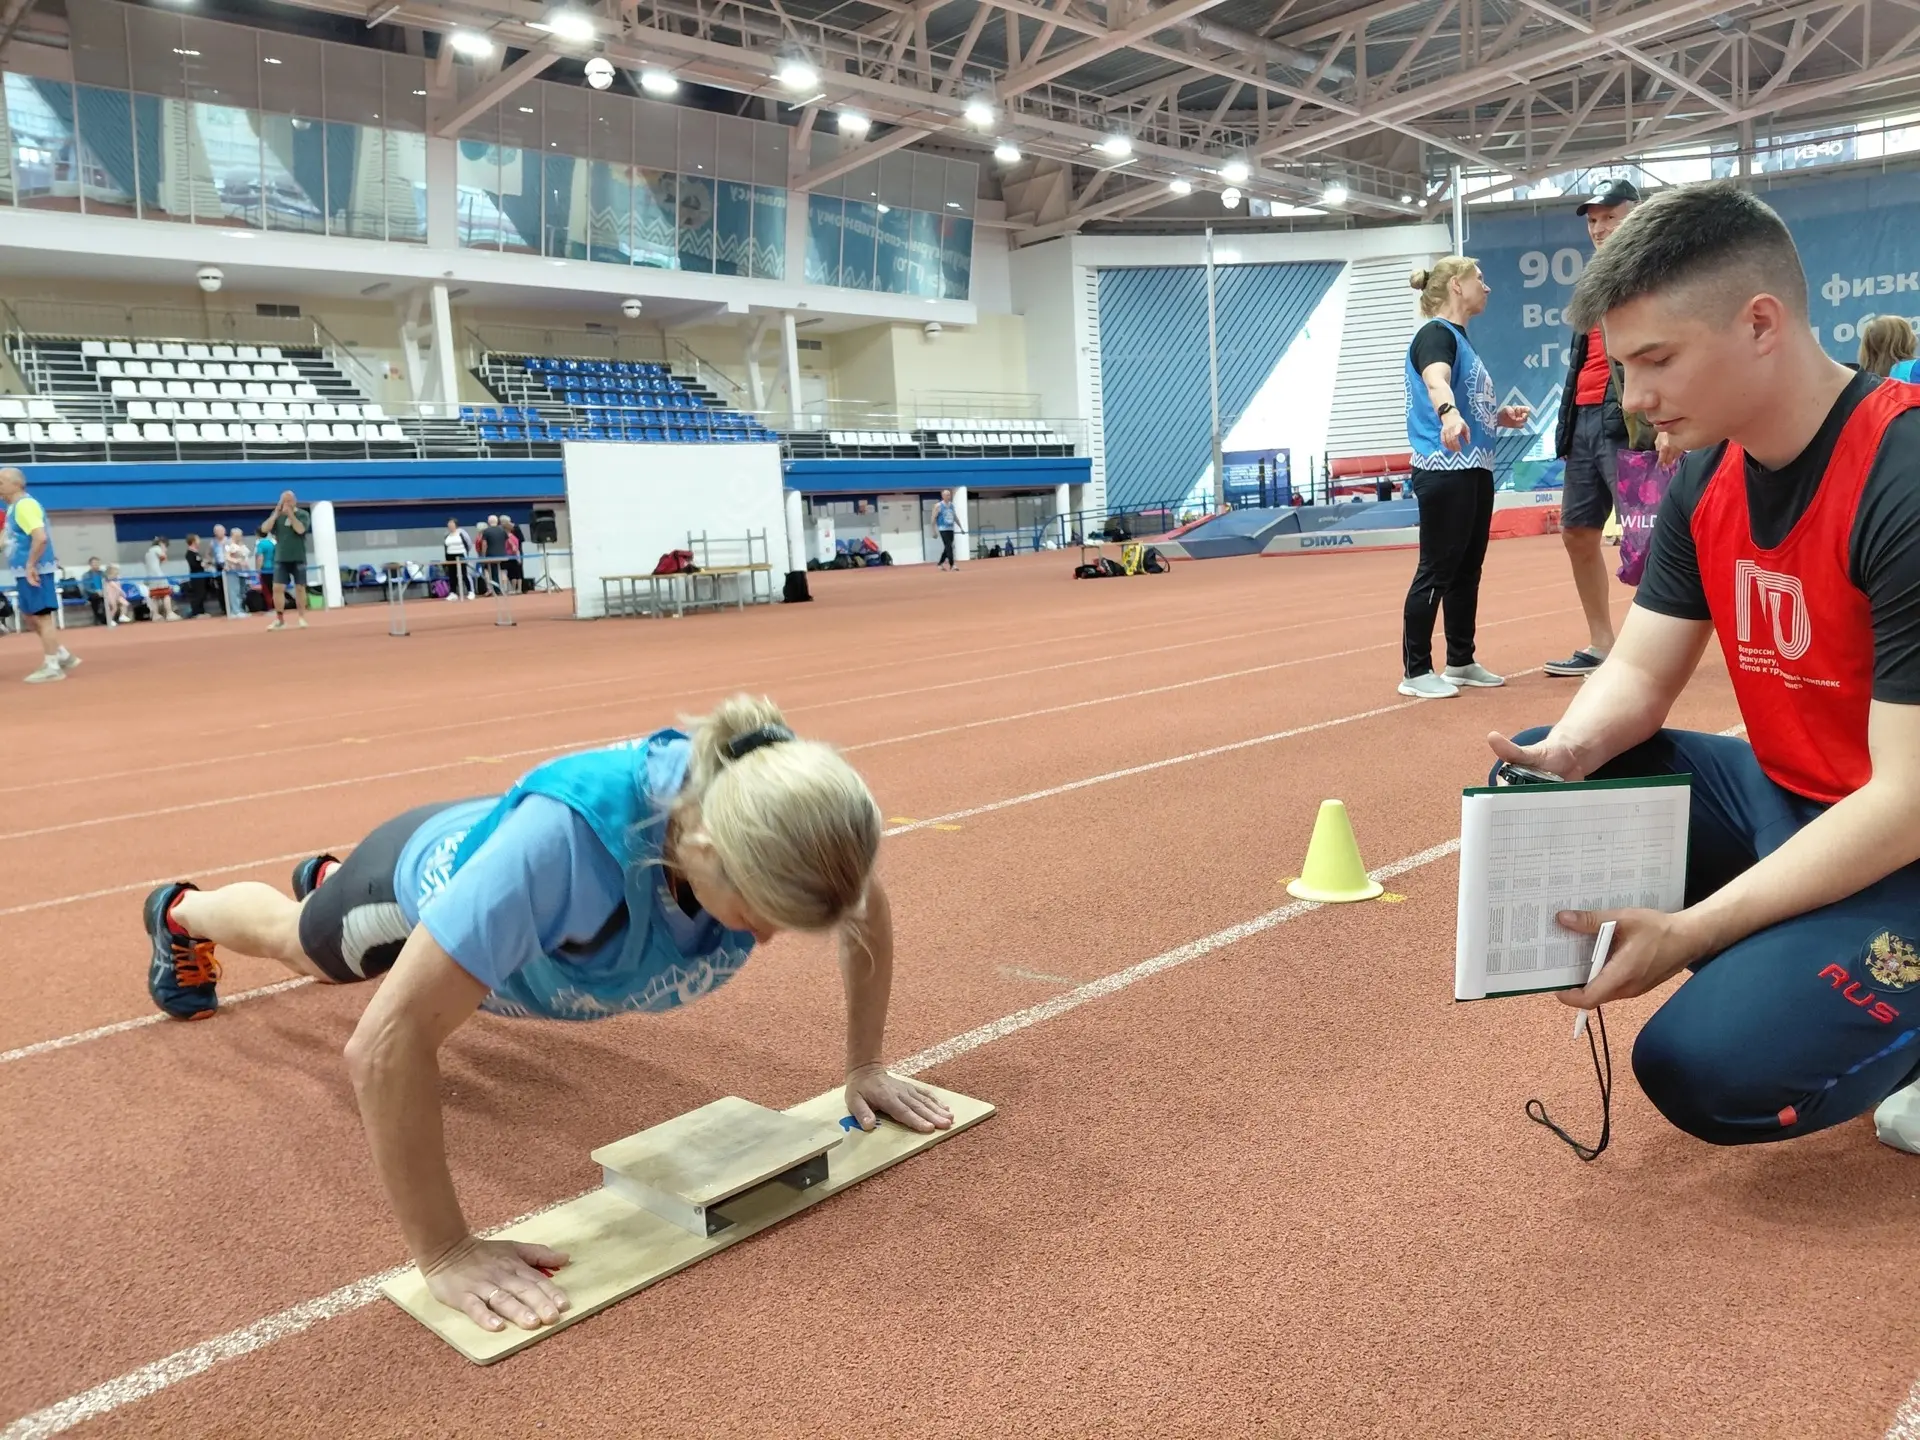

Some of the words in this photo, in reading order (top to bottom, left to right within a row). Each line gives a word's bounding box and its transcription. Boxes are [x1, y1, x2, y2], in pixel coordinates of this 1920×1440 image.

[1535, 493, 1553, 503] DIMA
[1300, 534, 1354, 548] DIMA
[1818, 963, 1900, 1024] RUS
